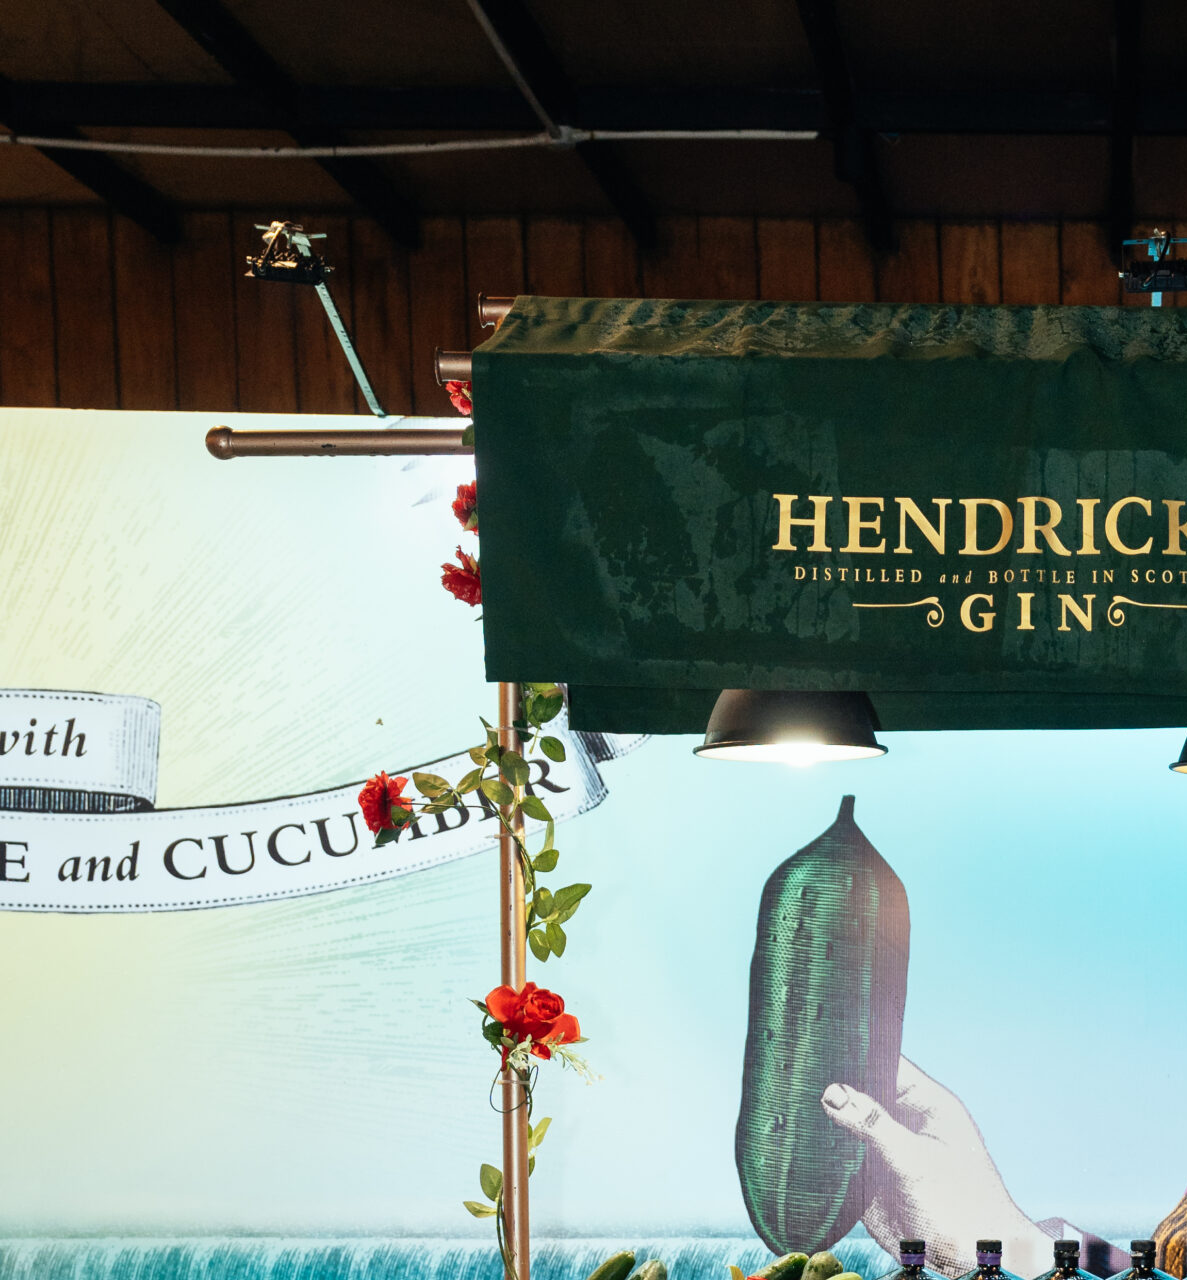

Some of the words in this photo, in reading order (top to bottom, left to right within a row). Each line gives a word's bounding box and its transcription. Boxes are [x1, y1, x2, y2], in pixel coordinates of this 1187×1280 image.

[794, 566, 922, 583] DISTILLED
[939, 569, 973, 584] and
[988, 569, 1076, 584] BOTTLE
[1092, 569, 1114, 584] IN
[960, 592, 1097, 632] GIN
[57, 841, 140, 882] and
